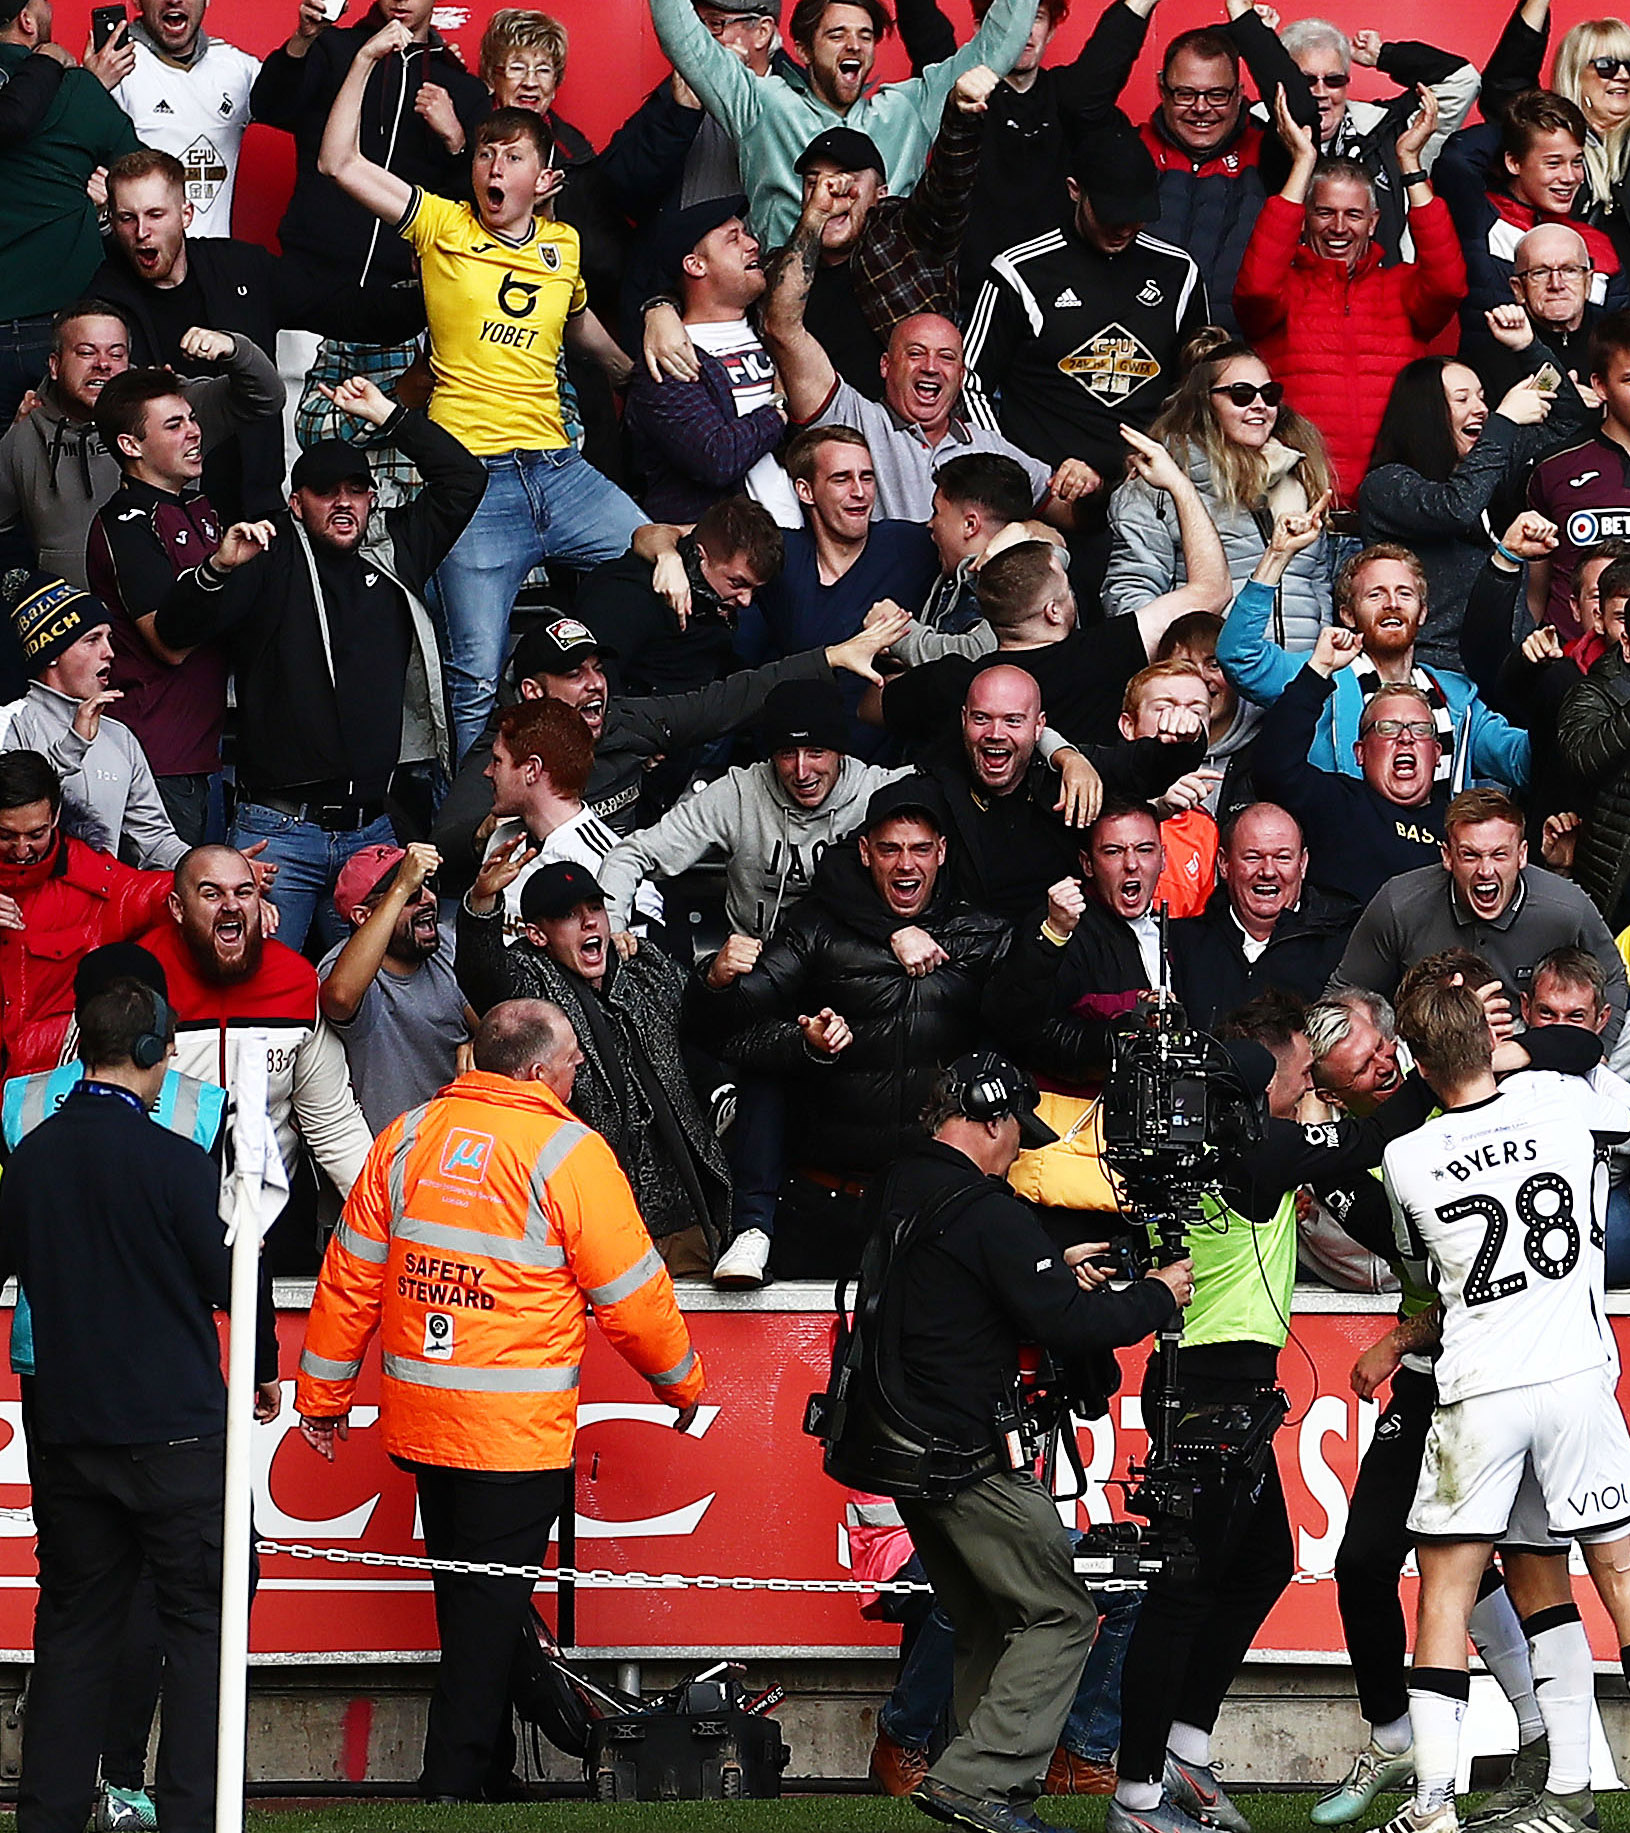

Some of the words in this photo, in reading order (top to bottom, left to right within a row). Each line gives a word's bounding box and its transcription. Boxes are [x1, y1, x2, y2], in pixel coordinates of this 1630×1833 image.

[479, 320, 539, 349] YOBET
[723, 353, 774, 384] FIL
[1446, 1139, 1537, 1182] BYERS
[1434, 1171, 1581, 1308] 28
[405, 1252, 486, 1288] SAFETY
[398, 1275, 496, 1310] STEWARD
